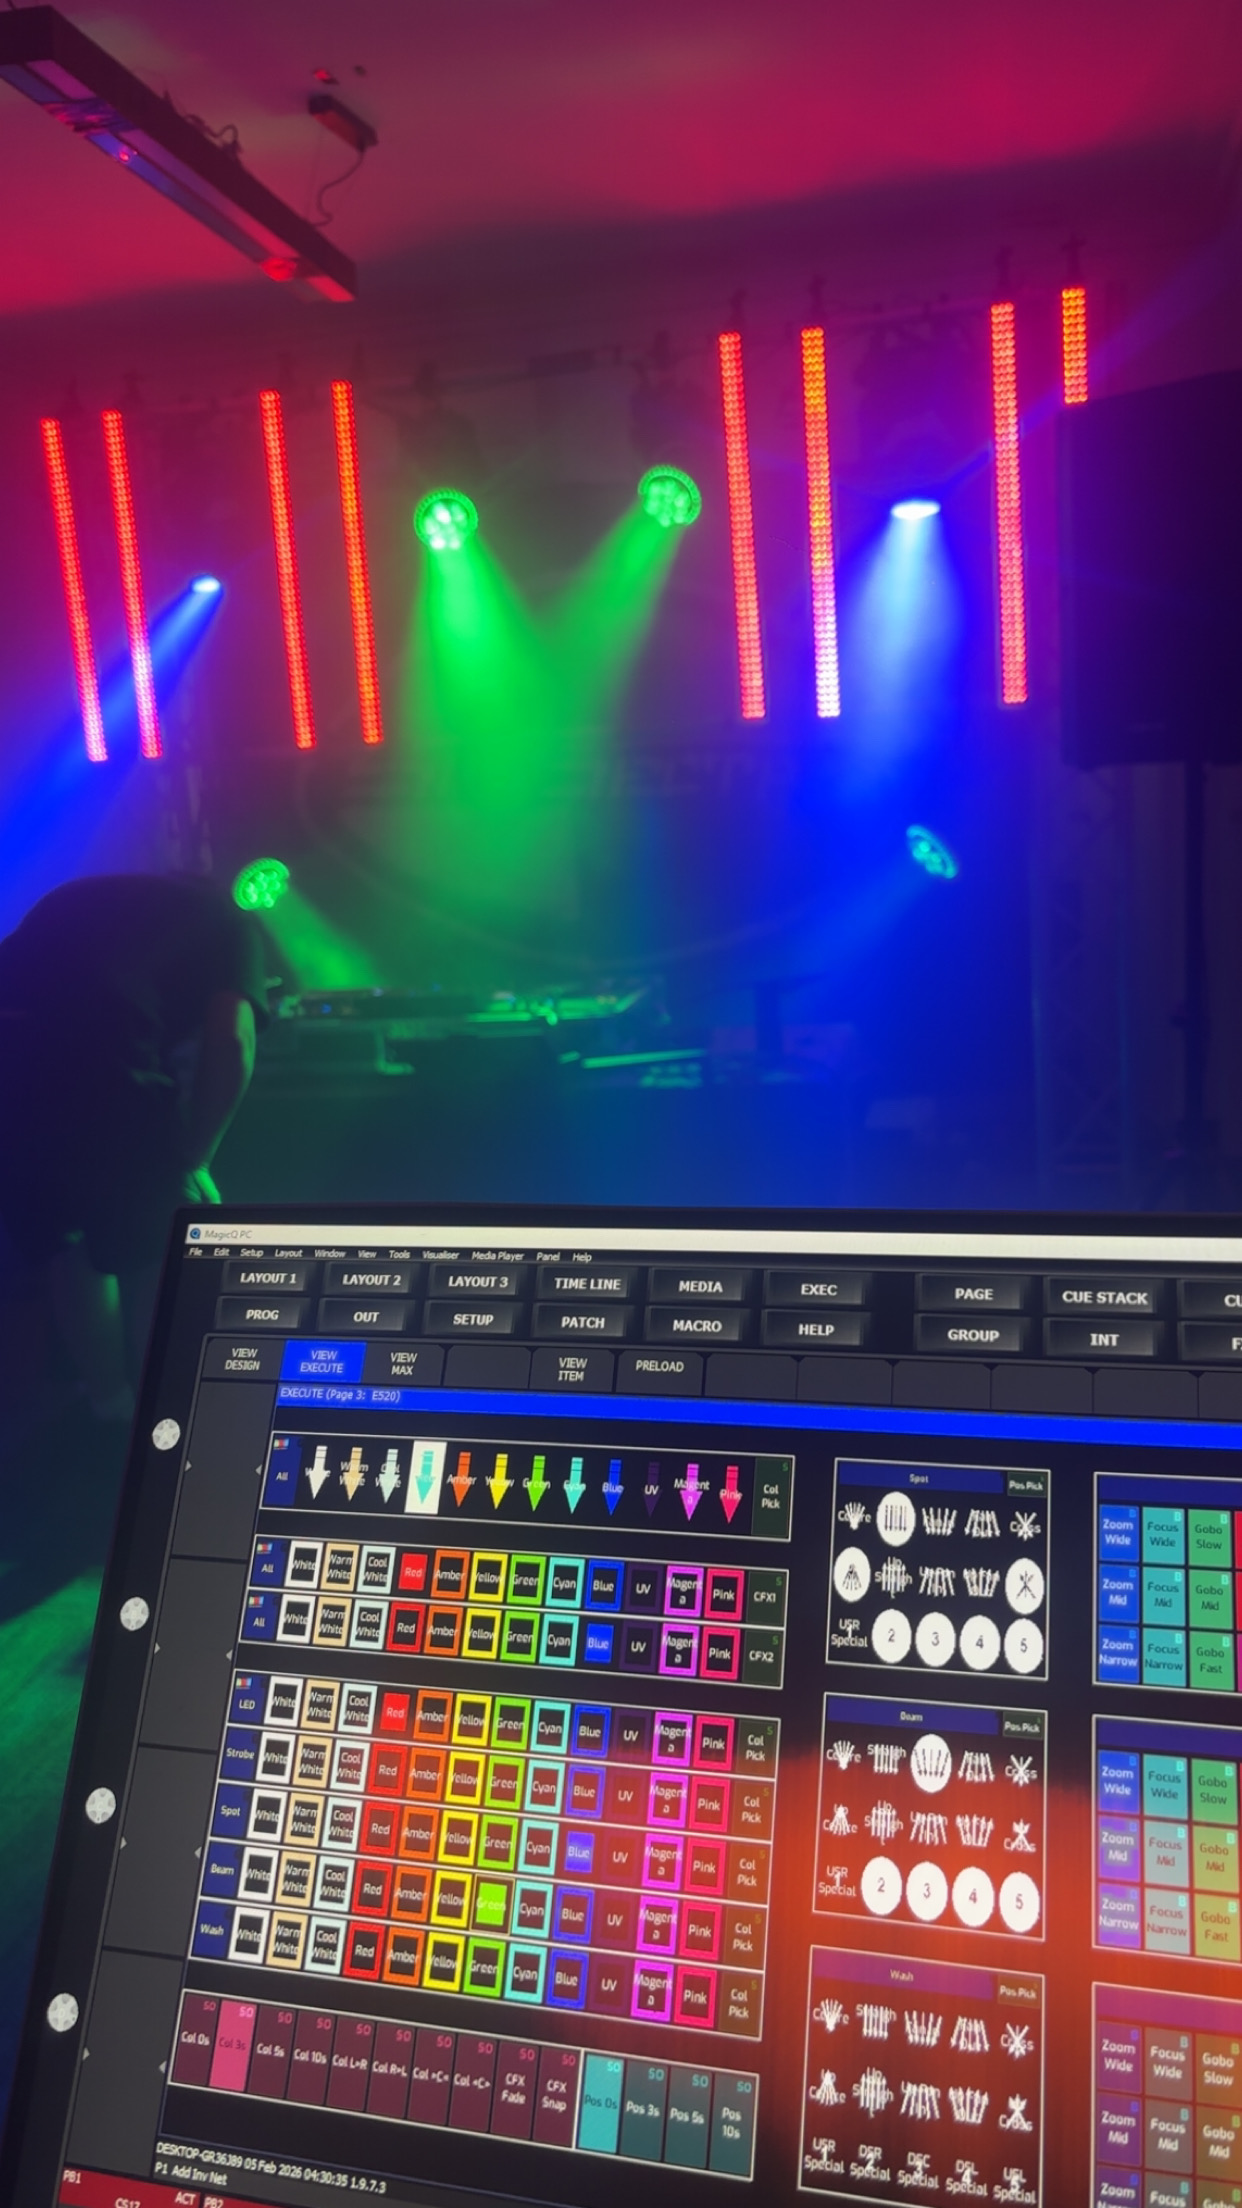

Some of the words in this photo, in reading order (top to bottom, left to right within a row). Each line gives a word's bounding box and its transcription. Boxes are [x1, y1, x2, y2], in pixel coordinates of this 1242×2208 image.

[205, 1230, 238, 1240] MagicQ
[239, 1230, 252, 1239] PC
[189, 1248, 202, 1256] File
[214, 1248, 229, 1257] Edit
[240, 1249, 263, 1258] Setup
[275, 1249, 303, 1259] Layout
[315, 1250, 346, 1258] Window
[358, 1250, 377, 1259] View
[389, 1250, 410, 1259] Tools
[423, 1251, 459, 1260] Visualiser
[472, 1251, 496, 1260] Media
[498, 1252, 524, 1262] Player
[537, 1252, 560, 1261] Panel
[573, 1253, 591, 1263] Help
[240, 1273, 287, 1283] LAYOUT
[290, 1274, 296, 1284] 1
[343, 1274, 390, 1285] LAYOUT
[392, 1276, 401, 1285] 2
[449, 1276, 497, 1287] LAYOUT
[500, 1277, 509, 1287] 3
[555, 1278, 586, 1290] TIME
[590, 1279, 621, 1290] LINE
[679, 1281, 723, 1292] MEDIA
[801, 1284, 837, 1296] EXEC
[955, 1288, 993, 1300] PAGE
[1062, 1291, 1092, 1303] CUE
[1097, 1292, 1148, 1305] STACK
[246, 1310, 279, 1320] PROG
[354, 1312, 379, 1323] OUT
[453, 1314, 493, 1325] SETUP
[562, 1316, 605, 1329] PATCH
[673, 1320, 721, 1332] MACRO
[799, 1324, 834, 1336] HELP
[948, 1330, 999, 1342] GROUP
[1091, 1334, 1120, 1346] INT
[232, 1348, 258, 1358] VIEW
[311, 1350, 338, 1360] VIEW
[390, 1352, 417, 1363] VIEW
[225, 1360, 260, 1371] DESIGN
[301, 1363, 343, 1373] EXECUTE
[559, 1357, 588, 1369] VIEW
[636, 1360, 684, 1372] PRELOAD
[392, 1365, 413, 1375] MAX
[558, 1371, 584, 1381] ITEM
[280, 1388, 324, 1398] EXECUTE
[326, 1389, 353, 1400] (Page
[356, 1391, 366, 1399] 3:
[372, 1391, 400, 1403] E520)
[276, 1472, 289, 1480] All
[909, 1474, 929, 1484] Spot
[602, 1483, 623, 1493] Blue
[644, 1485, 659, 1495] UV
[763, 1484, 779, 1495] Col
[1009, 1481, 1024, 1490] Pos
[1026, 1482, 1043, 1491] Pick
[761, 1497, 780, 1509] Pick
[1103, 1519, 1133, 1530] Zoom
[1148, 1522, 1178, 1532] Focus
[1195, 1524, 1223, 1534] Gobo
[1105, 1535, 1131, 1545] Wide
[1150, 1537, 1176, 1547] Wide
[1196, 1540, 1222, 1549] Slow
[368, 1557, 387, 1567] Cool
[261, 1564, 274, 1573] All
[405, 1567, 422, 1577] Red
[434, 1569, 464, 1580] Amber
[512, 1575, 539, 1586] Green
[553, 1577, 576, 1589] Cyan
[593, 1581, 614, 1591] Blue
[1103, 1579, 1133, 1590] Zoom
[636, 1584, 650, 1594] UV
[713, 1589, 734, 1600] Pink
[754, 1591, 776, 1603] CFX1
[1109, 1595, 1127, 1605] Mid
[253, 1618, 265, 1627] All
[360, 1612, 379, 1622] Cool
[888, 1629, 895, 1642] 2
[932, 1632, 939, 1646] 3
[588, 1638, 609, 1648] Blue
[976, 1636, 984, 1649] 4
[1020, 1639, 1027, 1652] 5
[1103, 1639, 1134, 1650] Zoom
[709, 1648, 731, 1660] Pink
[1148, 1644, 1179, 1655] Focus
[1196, 1647, 1224, 1657] Gobo
[749, 1650, 774, 1662] CFX2
[1100, 1655, 1137, 1667] Narrow
[1145, 1660, 1183, 1671] Narrow
[1200, 1664, 1223, 1674] Fast
[239, 1700, 255, 1710] LED
[349, 1696, 368, 1706] Cool
[386, 1708, 405, 1718] Red
[579, 1725, 601, 1738] Blue
[1005, 1722, 1021, 1731] Pos
[1022, 1723, 1040, 1733] Pick
[703, 1738, 725, 1749] Pink
[748, 1735, 764, 1746] Col
[226, 1748, 254, 1760] Strobe
[746, 1750, 765, 1761] Pick
[379, 1765, 397, 1776] Red
[1102, 1766, 1133, 1778] Zoom
[1148, 1771, 1181, 1783] Focus
[1198, 1775, 1227, 1788] Gobo
[1104, 1783, 1131, 1795] Wide
[1151, 1788, 1179, 1799] Wide
[1200, 1793, 1227, 1804] Slow
[698, 1799, 720, 1810] Pink
[221, 1805, 241, 1817] Spot
[568, 1846, 589, 1858] Blue
[211, 1864, 234, 1875] Beam
[363, 1883, 382, 1895] Red
[200, 1923, 224, 1935] Wash
[688, 1924, 711, 1937] Pink
[355, 1944, 374, 1957] Red
[555, 1972, 577, 1986] Blue
[890, 1970, 913, 1981] Wash
[684, 1990, 707, 2004] Pink
[731, 1988, 747, 2001] Col
[729, 2005, 749, 2018] Pick
[181, 2032, 196, 2043] Col
[198, 2034, 210, 2045] 0s
[257, 2043, 272, 2055] Col
[274, 2046, 284, 2058] 5s
[1102, 2039, 1136, 2054] Zoom
[294, 2049, 309, 2061] Col
[310, 2052, 326, 2064] 10s
[1151, 2046, 1185, 2061] Focus
[1104, 2058, 1133, 2072] Wide
[1202, 2053, 1234, 2068] Gobo
[1153, 2064, 1182, 2079] Wide
[506, 2073, 525, 2086] CFX
[1204, 2071, 1234, 2086] Slow
[547, 2079, 567, 2092] CFX
[502, 2090, 526, 2104] Fade
[542, 2096, 567, 2112] Snap
[626, 2101, 645, 2115] Pos
[648, 2105, 660, 2117] 3s
[670, 2109, 690, 2122] Pos
[692, 2111, 704, 2124] 5s
[722, 2108, 742, 2121] Pos
[722, 2125, 740, 2139] 10s
[155, 2162, 168, 2175] P1
[171, 2165, 191, 2177] Add
[192, 2169, 207, 2180] Inv
[210, 2172, 227, 2185] Net
[244, 2158, 257, 2170] 05
[258, 2162, 276, 2173] Feb
[278, 2164, 302, 2178] 2026
[304, 2168, 348, 2187] 04:30:35
[350, 2177, 387, 2193] 1.9.7.3
[175, 2192, 196, 2205] ACT
